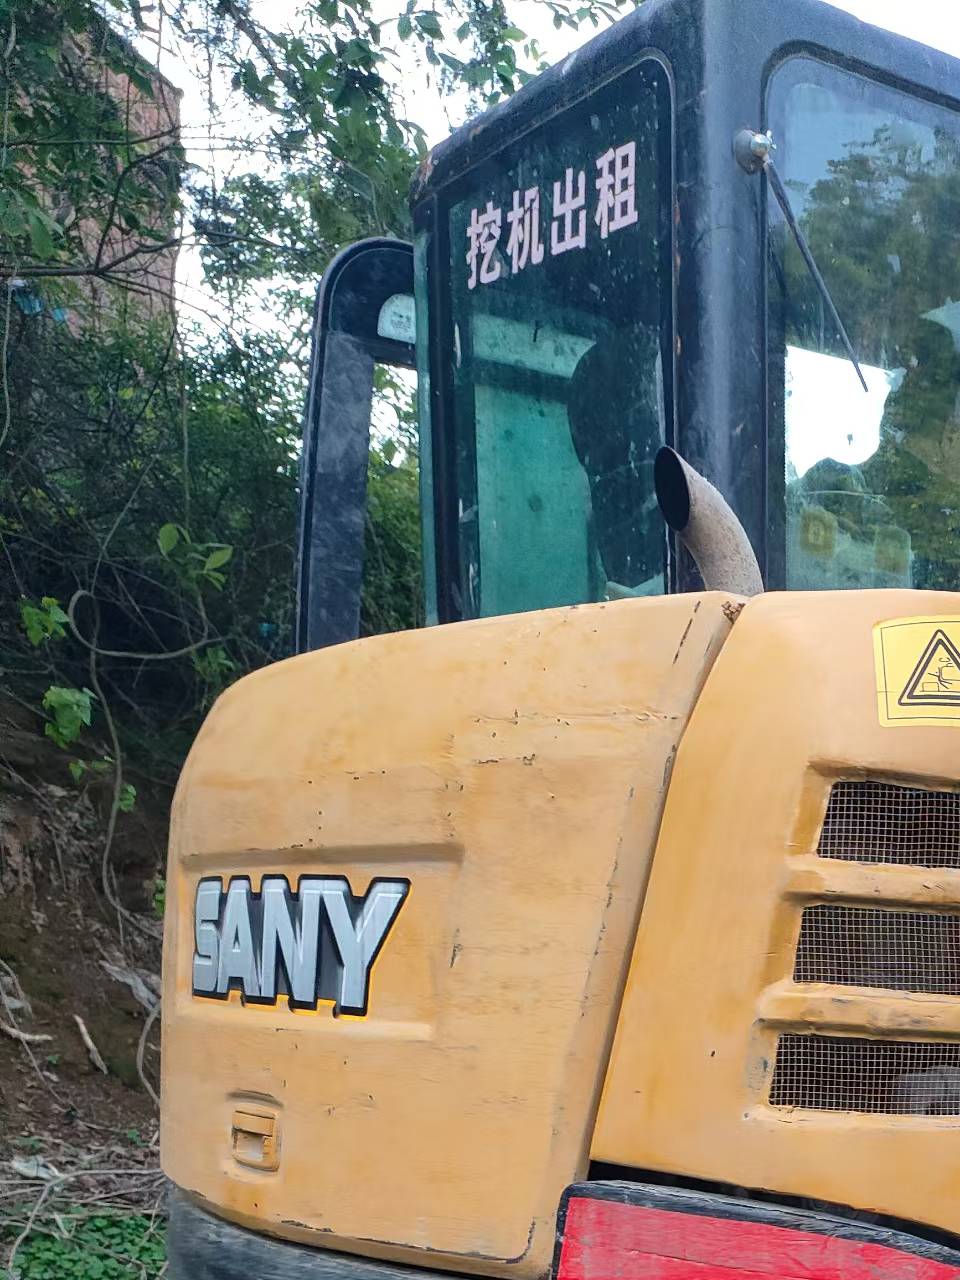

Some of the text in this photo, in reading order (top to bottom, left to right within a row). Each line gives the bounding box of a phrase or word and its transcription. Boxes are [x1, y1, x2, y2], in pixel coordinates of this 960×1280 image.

[466, 141, 639, 290] 挖机出租
[193, 873, 412, 1019] SANY
